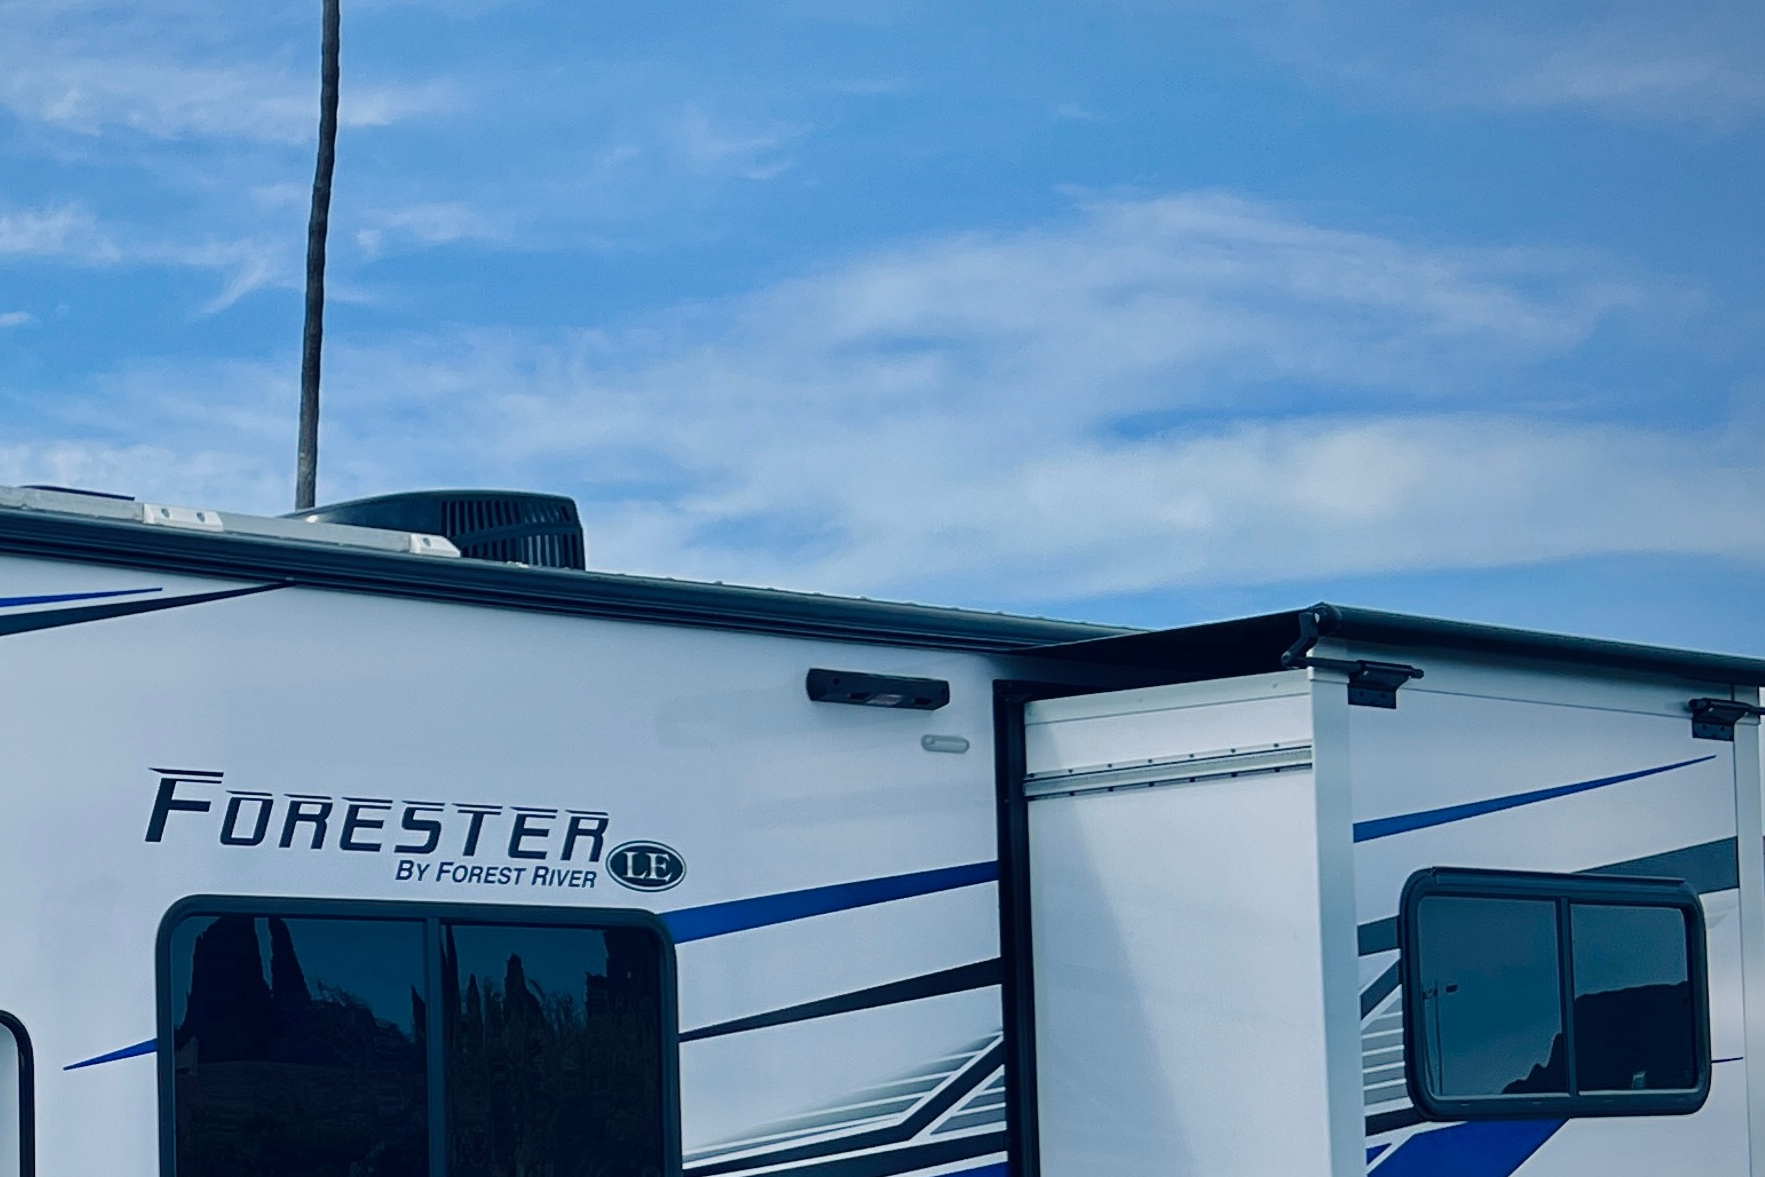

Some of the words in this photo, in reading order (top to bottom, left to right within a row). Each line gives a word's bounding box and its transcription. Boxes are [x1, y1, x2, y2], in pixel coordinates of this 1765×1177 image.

[144, 766, 610, 863] FORESTER
[395, 859, 430, 882] BY
[435, 861, 527, 886] FOREST
[531, 865, 598, 889] RIVER
[621, 849, 672, 882] LE
